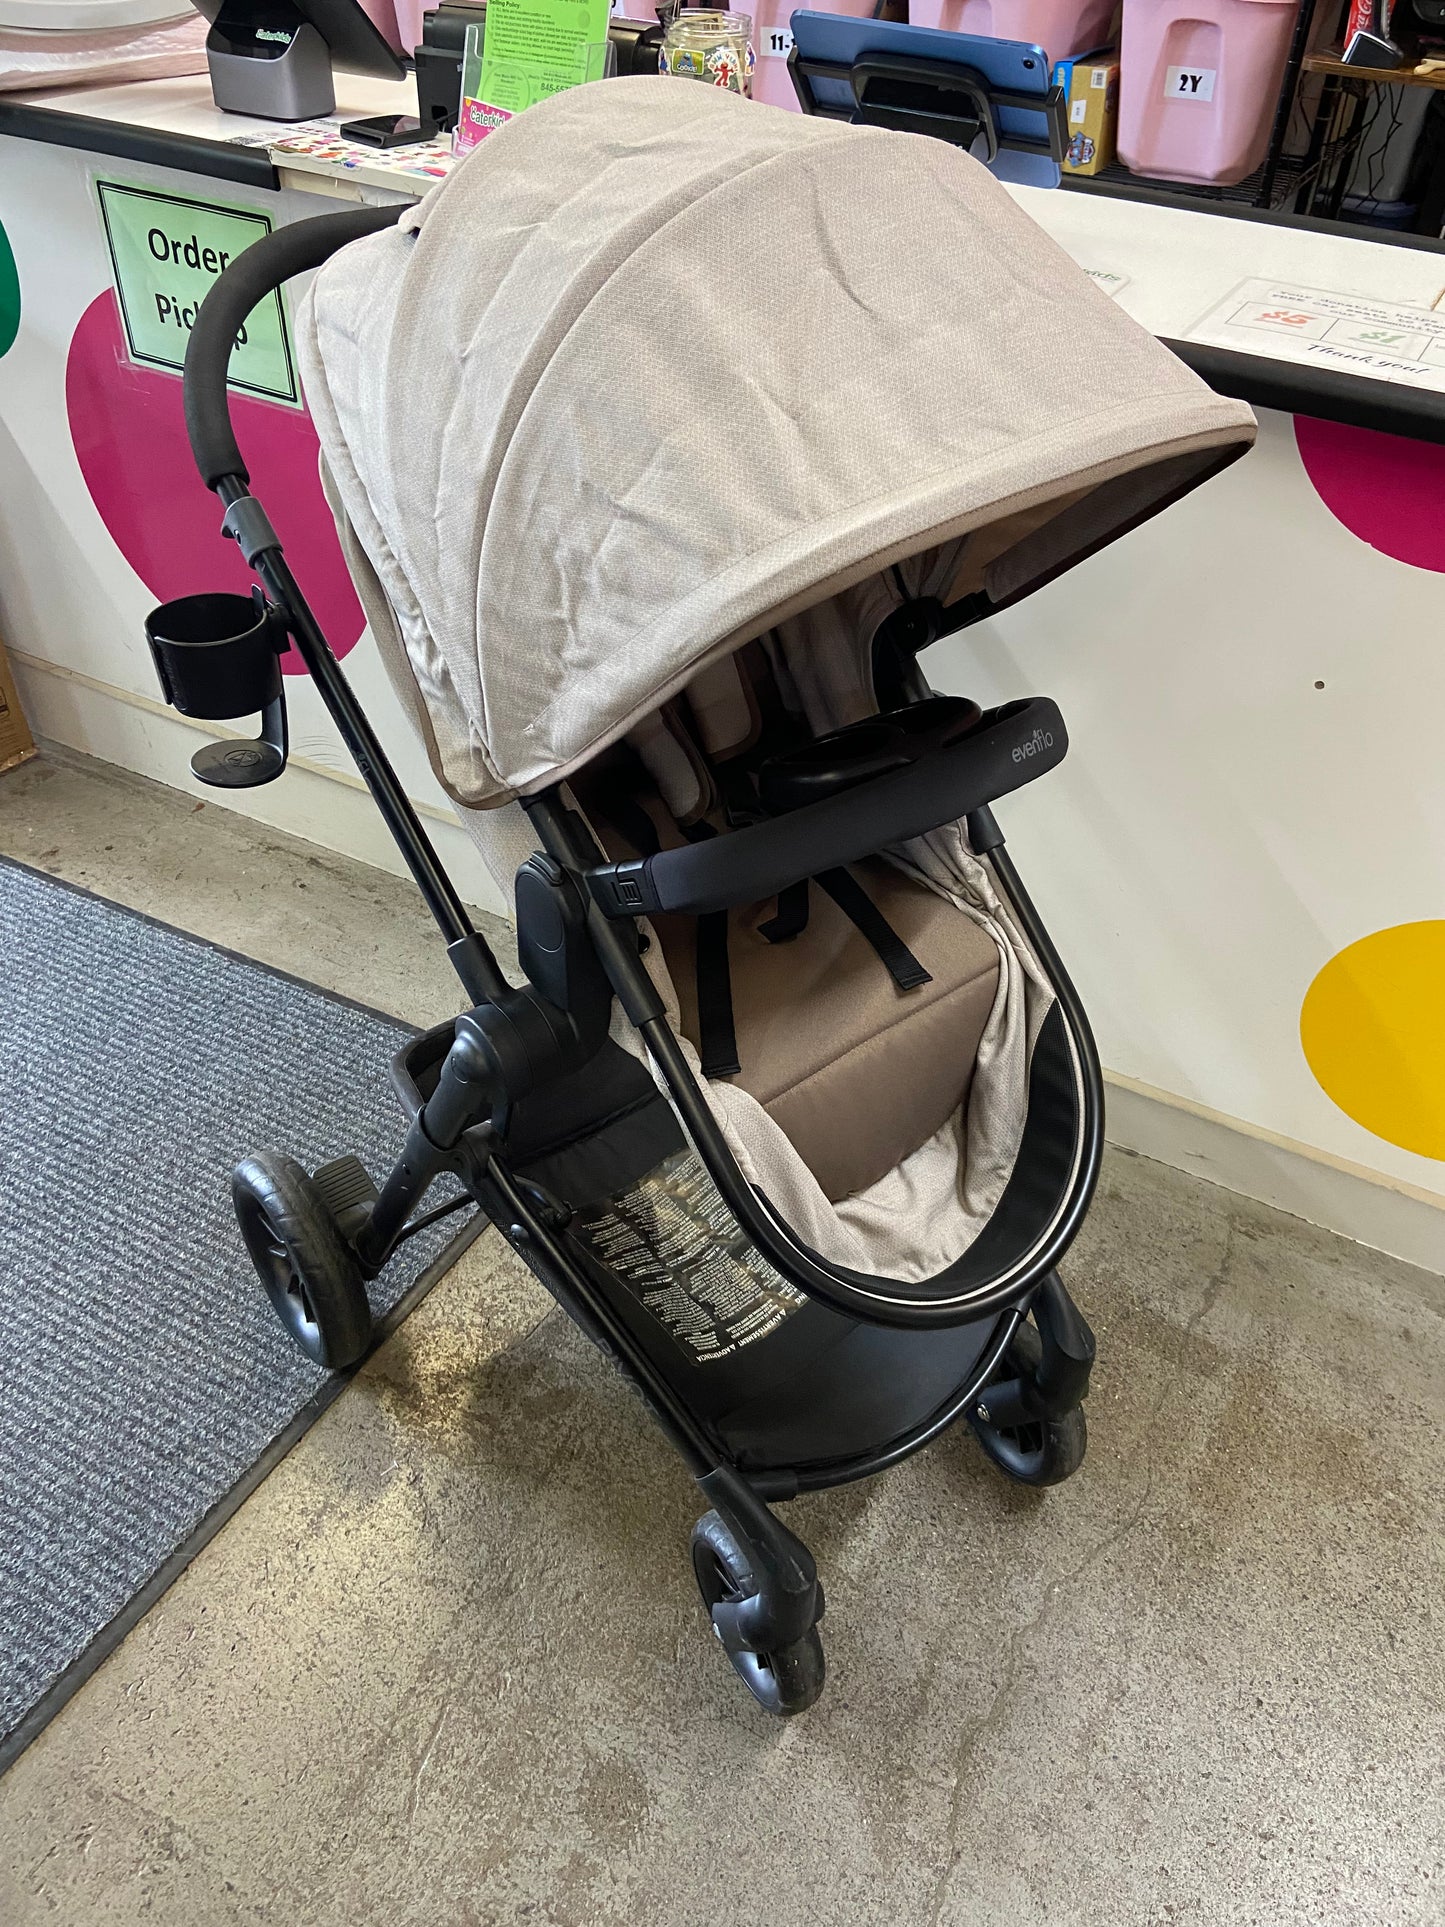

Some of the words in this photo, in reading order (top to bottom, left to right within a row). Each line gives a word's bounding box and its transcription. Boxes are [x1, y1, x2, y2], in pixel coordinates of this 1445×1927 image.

[1178, 74, 1203, 93] 2Y
[148, 228, 230, 273] Order
[155, 293, 248, 351] Picp
[1256, 310, 1319, 326] $5
[1320, 298, 1387, 315] donation
[1359, 331, 1407, 344] $1
[1306, 343, 1374, 364] Thank
[1372, 359, 1431, 375] you!
[1011, 728, 1054, 763] evenflo
[738, 1312, 782, 1347] AVERTISSEMENT
